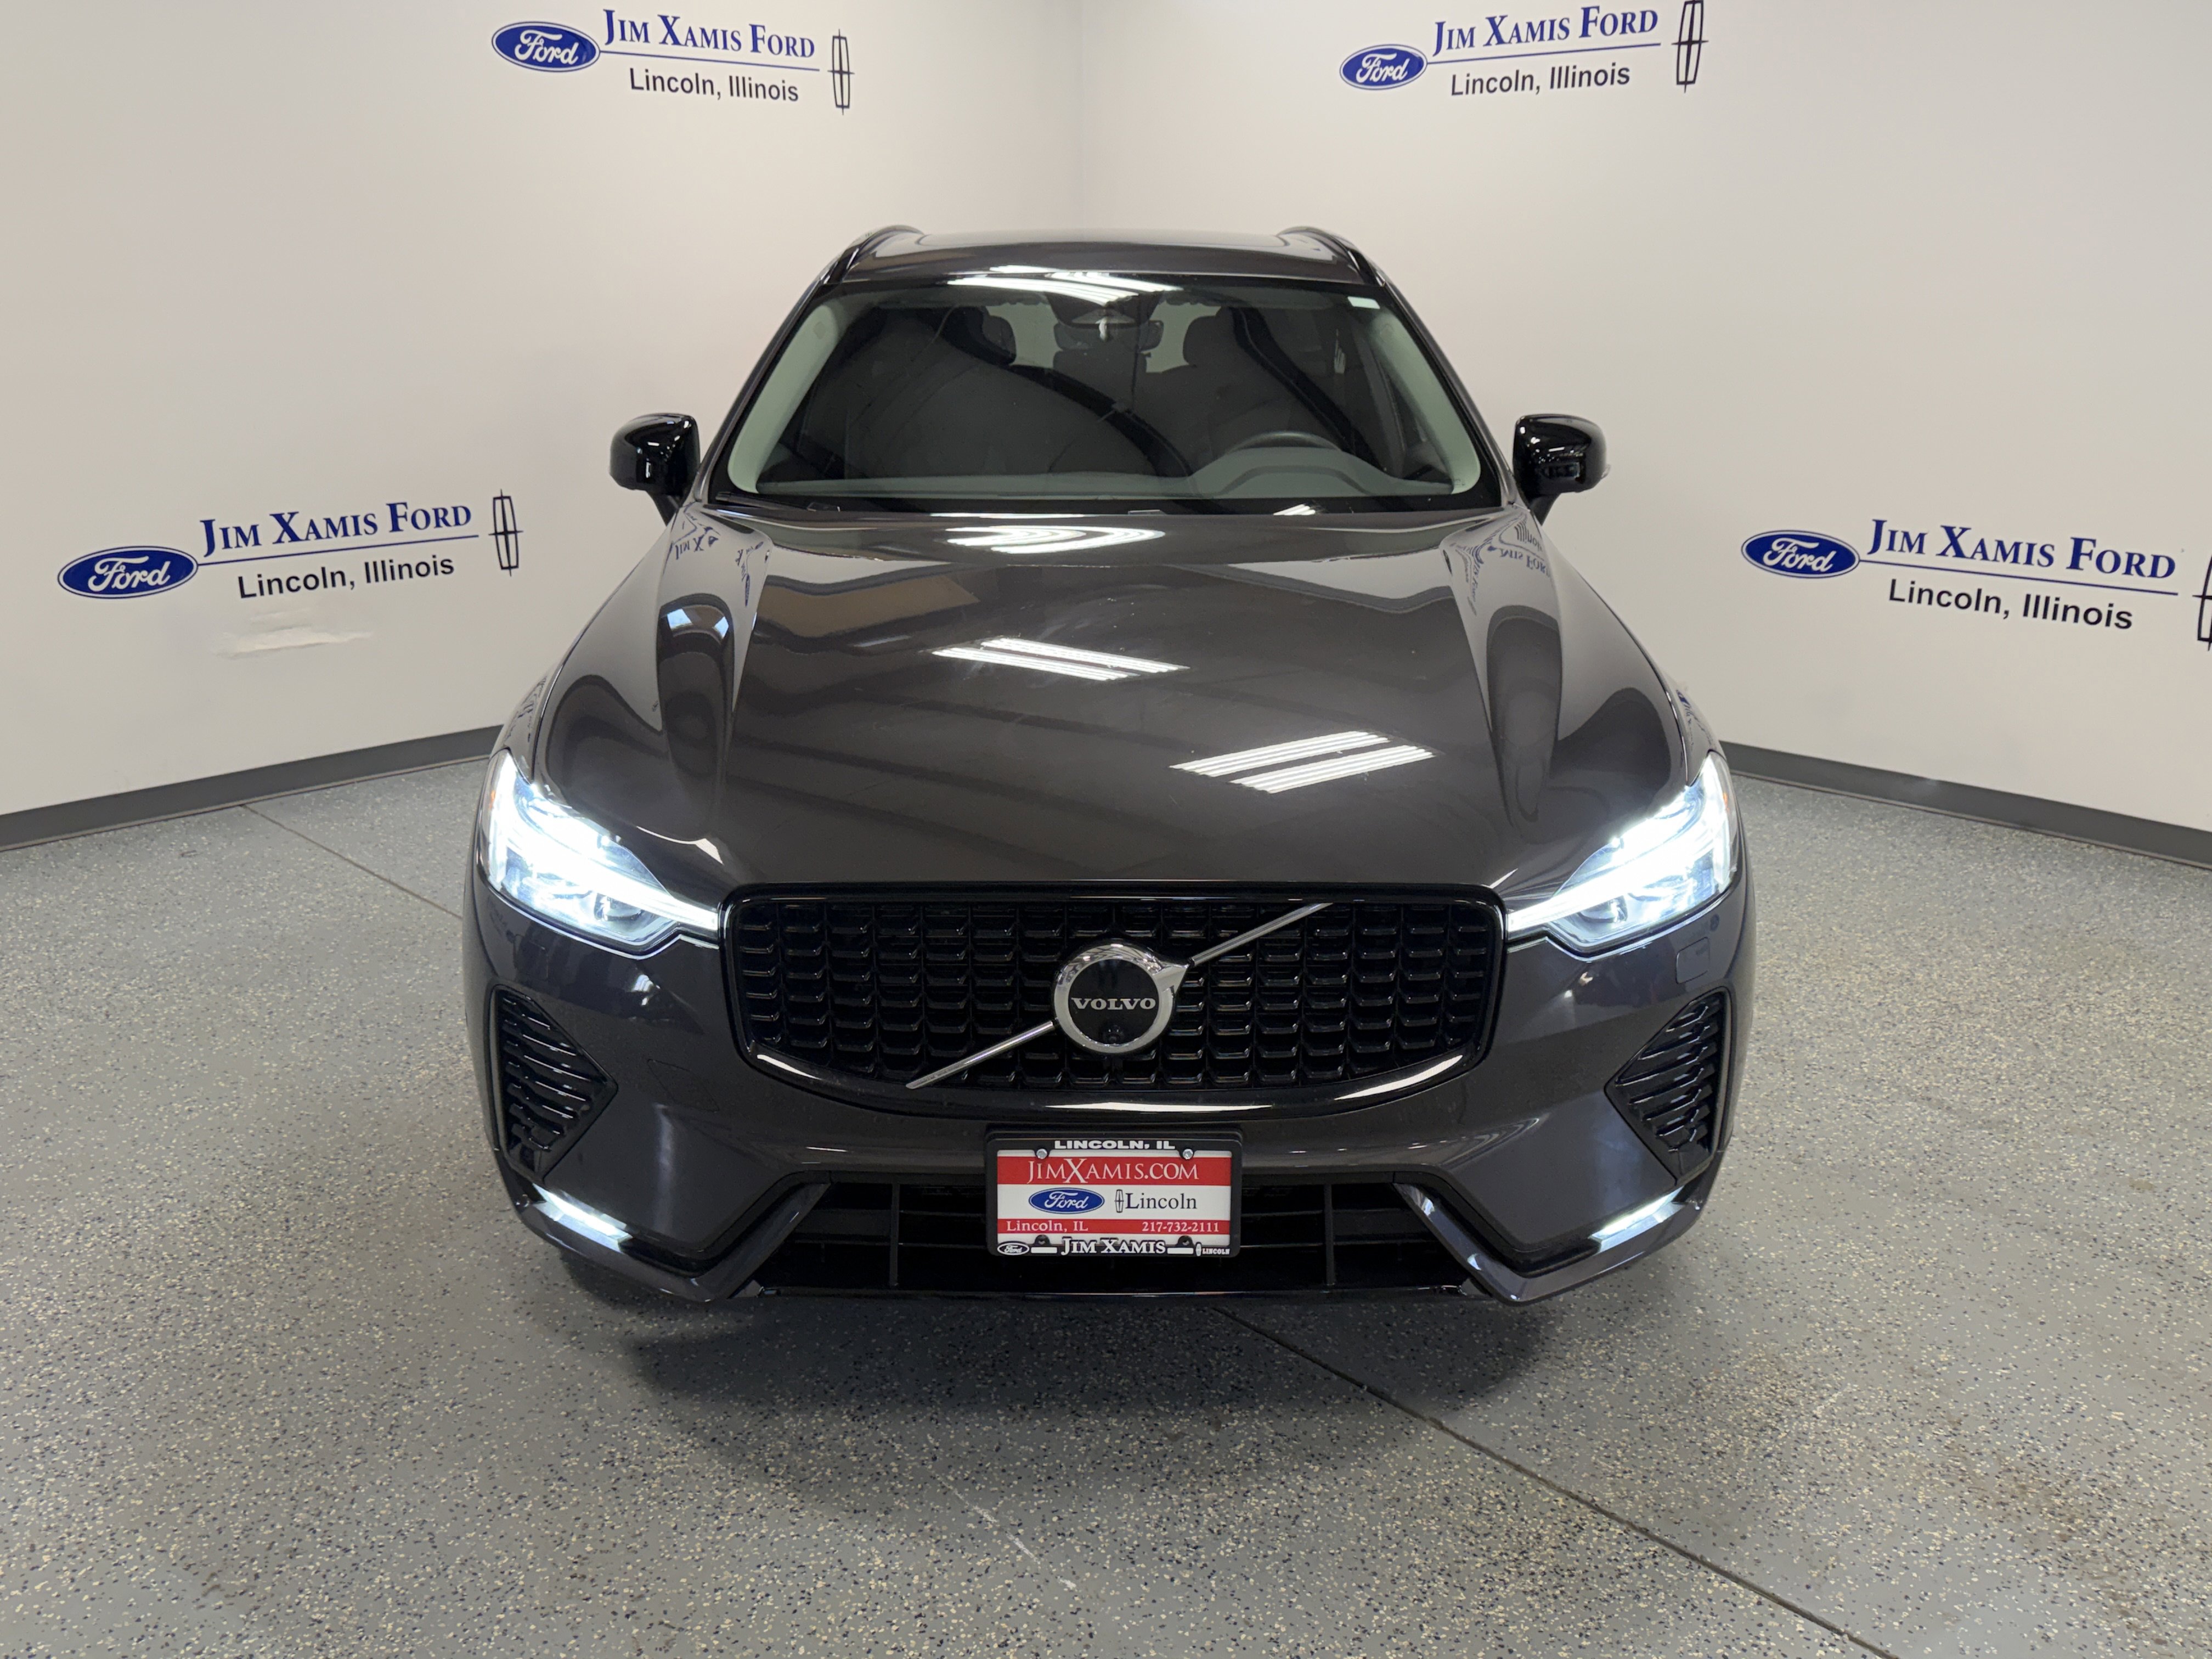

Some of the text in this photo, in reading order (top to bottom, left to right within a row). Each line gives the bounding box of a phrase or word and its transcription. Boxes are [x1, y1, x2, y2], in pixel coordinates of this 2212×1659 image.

[515, 30, 579, 66] Ford
[603, 9, 815, 58] JIM XAMIS FORD
[1432, 5, 1658, 57] JIM XAMIS FORD
[630, 67, 799, 101] Lincoln, Illinois
[1356, 53, 1408, 83] Ford
[1452, 62, 1630, 96] Lincoln, Illinois
[200, 502, 472, 558] JIM XAMIS FORD
[1763, 538, 1833, 572] Ford
[1867, 518, 2176, 580] JIM XAMIS FORD
[87, 555, 171, 591] Ford
[238, 555, 455, 599] Lincoln, Illinois
[1889, 578, 2133, 629] Lincoln, Illinois
[1071, 997, 1156, 1010] VOLVO
[1156, 1141, 1175, 1149] IL
[1027, 1158, 1199, 1184] JIMXAMIS.COM
[1044, 1191, 1089, 1210] Ford
[1125, 1193, 1197, 1209] Lincoln
[1006, 1220, 1088, 1232] Lincoln, IL
[1142, 1221, 1219, 1232] 217-732-2111
[1003, 1245, 1023, 1253] Ford
[1061, 1238, 1166, 1255] JIM XAMIS
